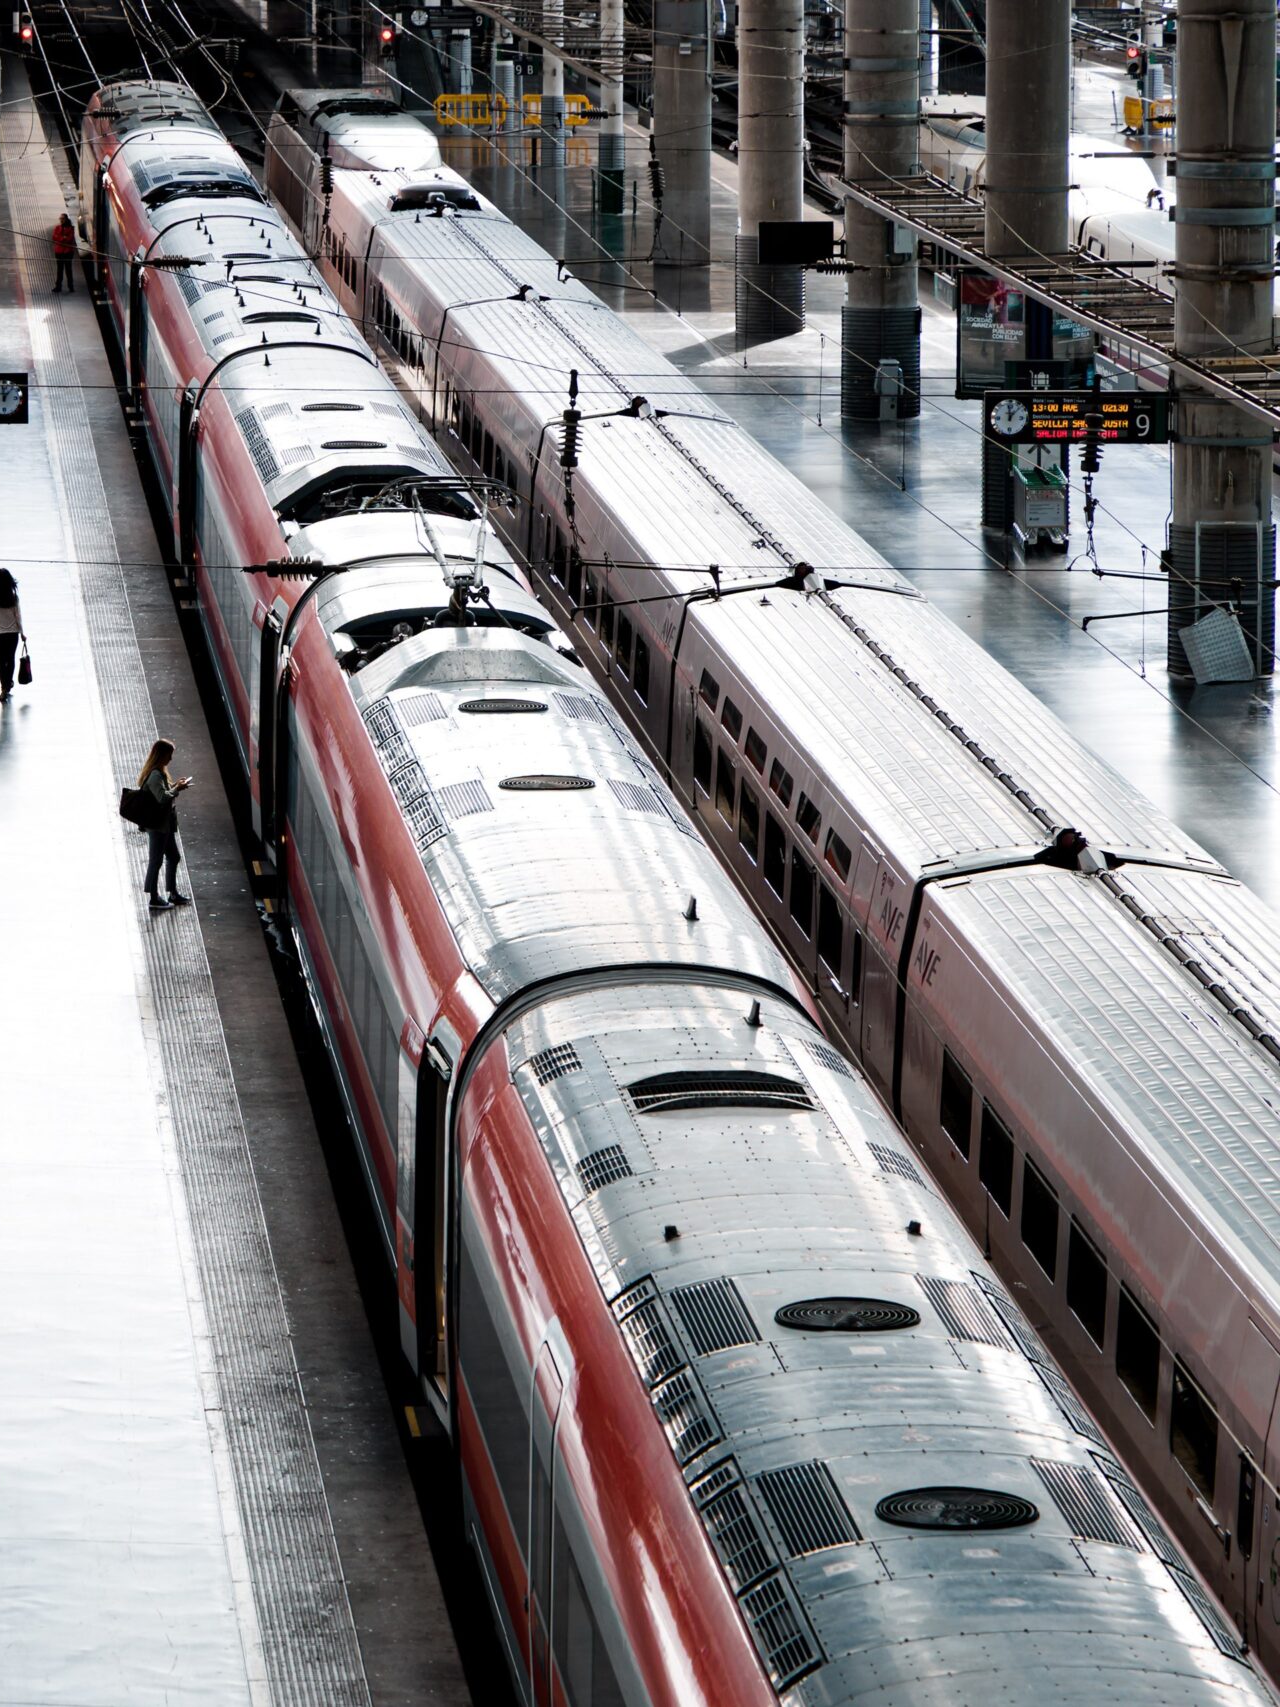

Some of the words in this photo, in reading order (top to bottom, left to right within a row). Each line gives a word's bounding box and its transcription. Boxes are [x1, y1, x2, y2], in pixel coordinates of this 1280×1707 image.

[475, 15, 483, 27] 9
[515, 64, 522, 75] 9
[1032, 404, 1059, 412] 13:00
[1062, 404, 1079, 412] AVE
[1102, 404, 1129, 412] 02130
[1032, 420, 1068, 428] SEVILLA
[1102, 420, 1129, 428] JUSTA
[1135, 414, 1150, 437] 9
[1036, 430, 1068, 438] SALIDA
[879, 896, 904, 943] AVE
[913, 938, 942, 987] AVE
